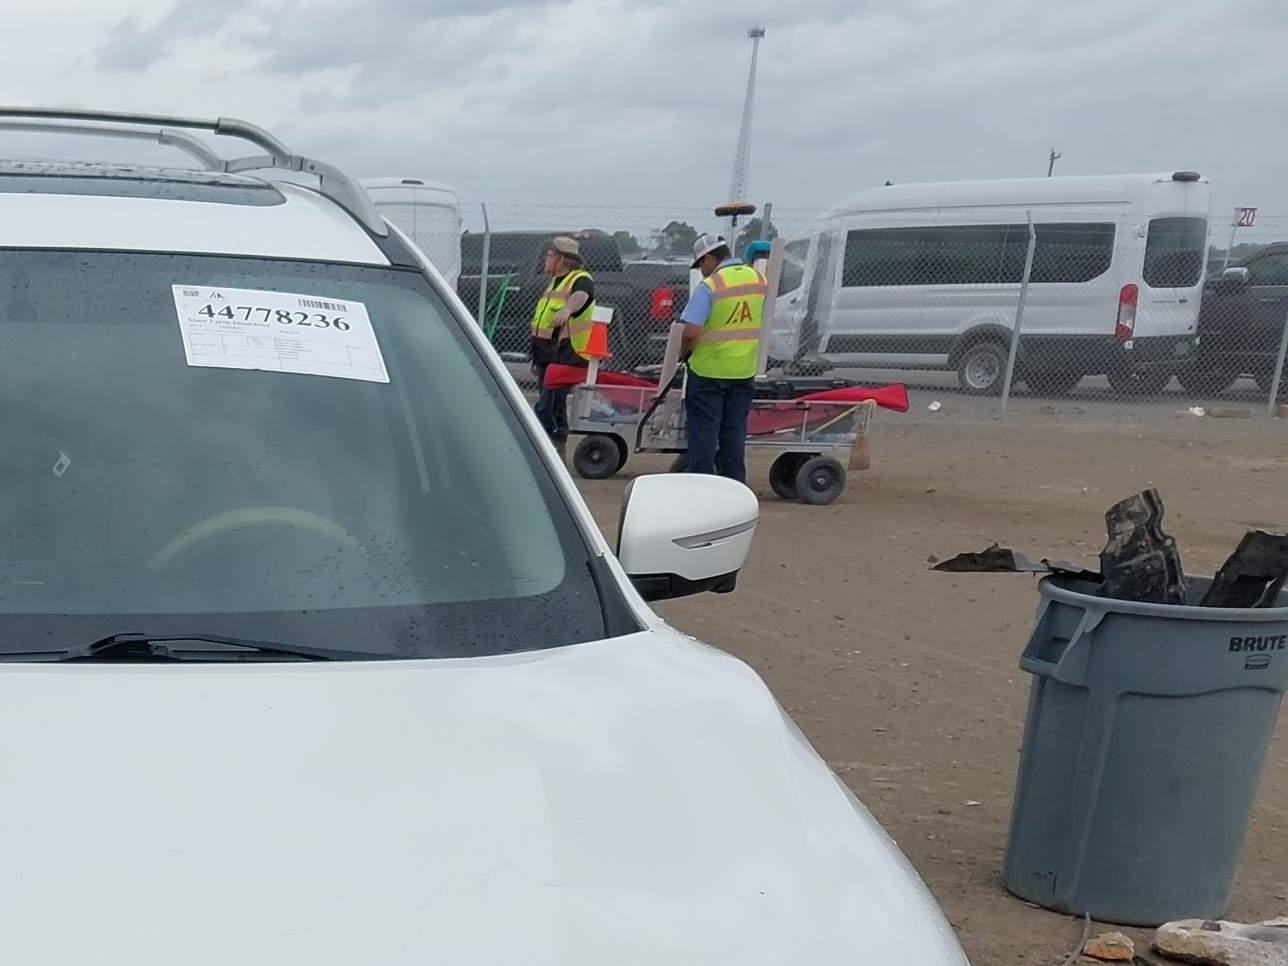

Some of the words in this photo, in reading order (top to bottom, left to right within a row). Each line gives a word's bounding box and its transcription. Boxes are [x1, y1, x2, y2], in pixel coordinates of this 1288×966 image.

[1239, 208, 1256, 226] 20
[198, 303, 351, 332] 44778236
[1228, 634, 1287, 652] BRUTE
